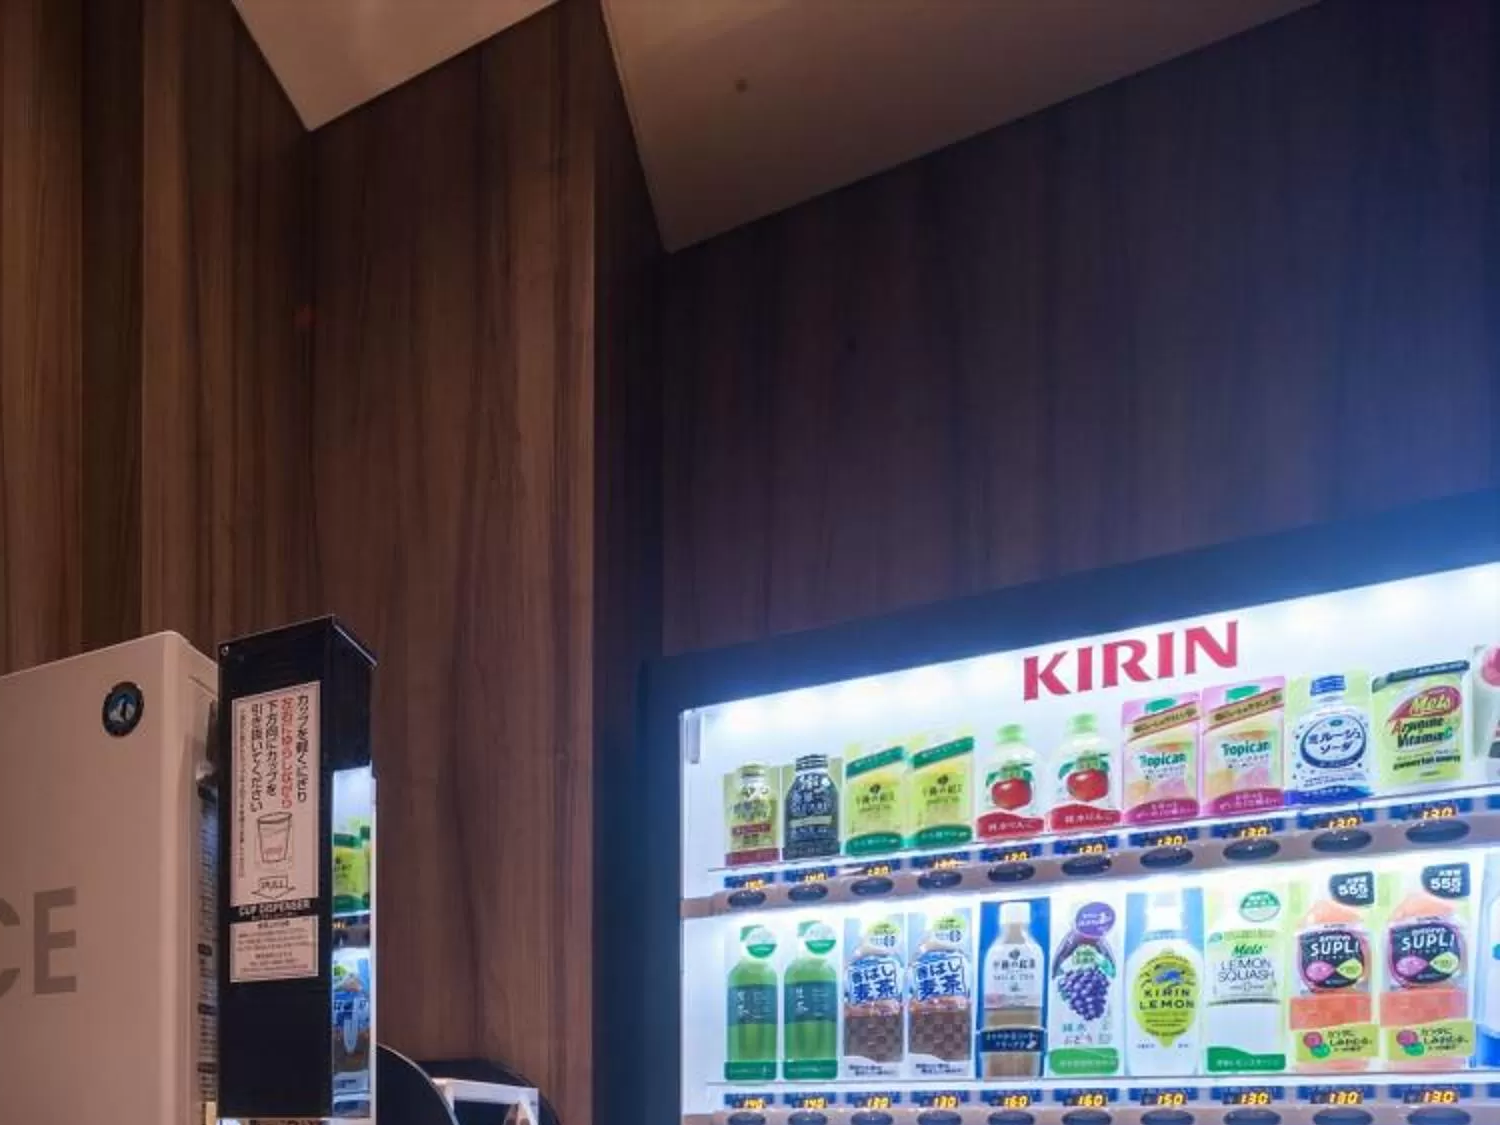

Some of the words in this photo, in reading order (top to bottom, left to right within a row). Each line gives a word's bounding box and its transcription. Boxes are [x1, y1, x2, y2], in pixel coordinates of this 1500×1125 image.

[1023, 620, 1239, 702] KIRIN
[1402, 932, 1455, 951] SUPLI
[1309, 942, 1360, 957] SUPLI
[1220, 957, 1272, 971] LEMON
[1217, 969, 1276, 983] SQUASH
[1143, 987, 1191, 998] KIRIN
[1139, 998, 1195, 1010] LEMON
[1157, 1094, 1183, 1105] 150
[1241, 1092, 1268, 1104] 130
[1424, 1091, 1454, 1103] 130
